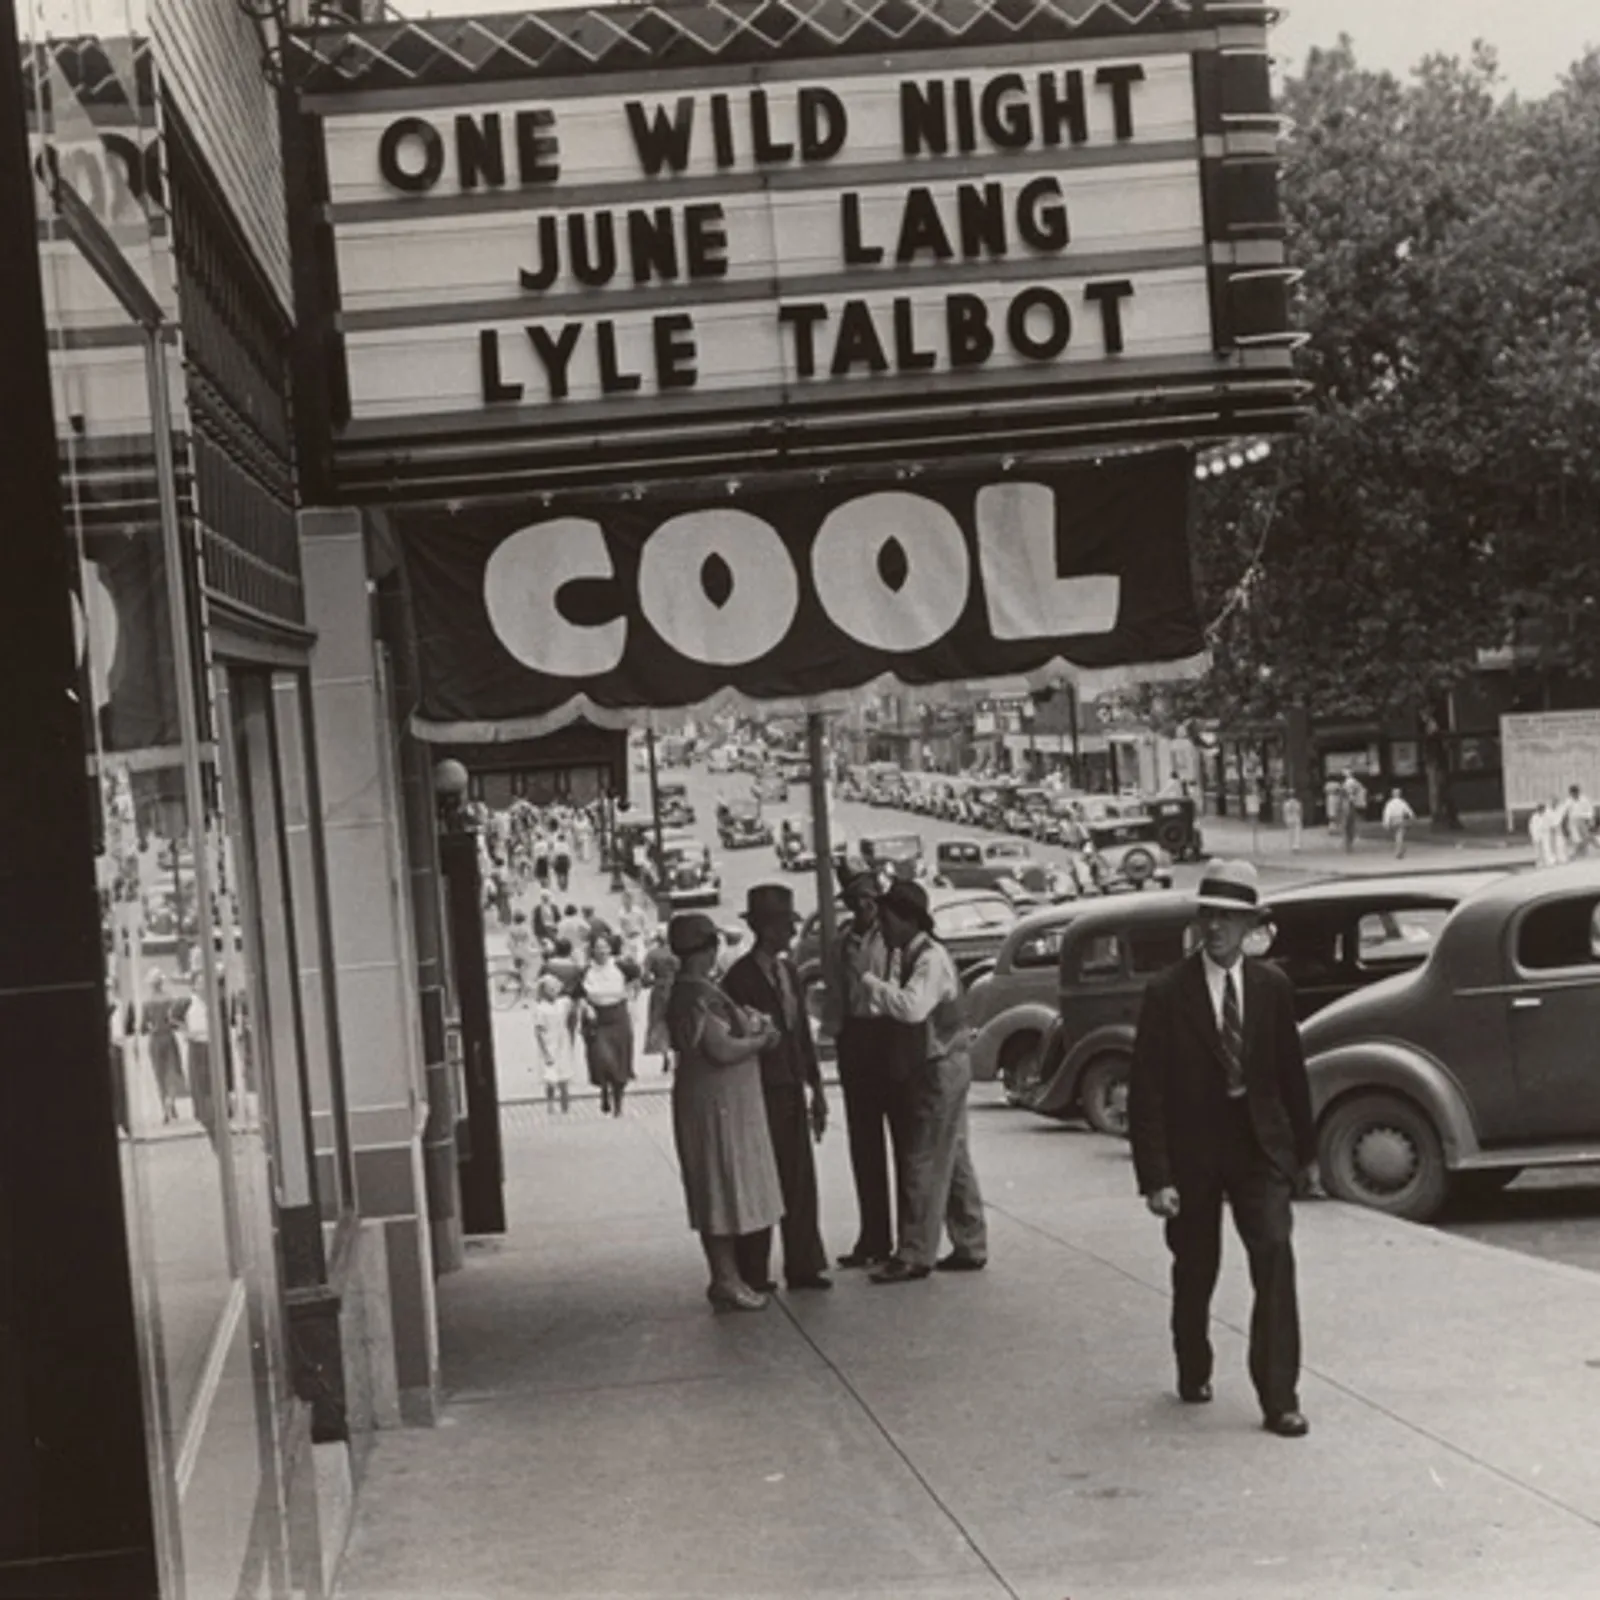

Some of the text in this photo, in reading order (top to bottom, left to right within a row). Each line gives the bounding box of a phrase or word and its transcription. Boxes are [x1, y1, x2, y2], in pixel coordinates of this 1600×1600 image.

[378, 65, 1145, 191] ONE WILD NIGHT
[519, 177, 1070, 290] JUNE LANG
[480, 280, 1134, 404] LYLE TALBOT
[484, 483, 1121, 677] COOL
